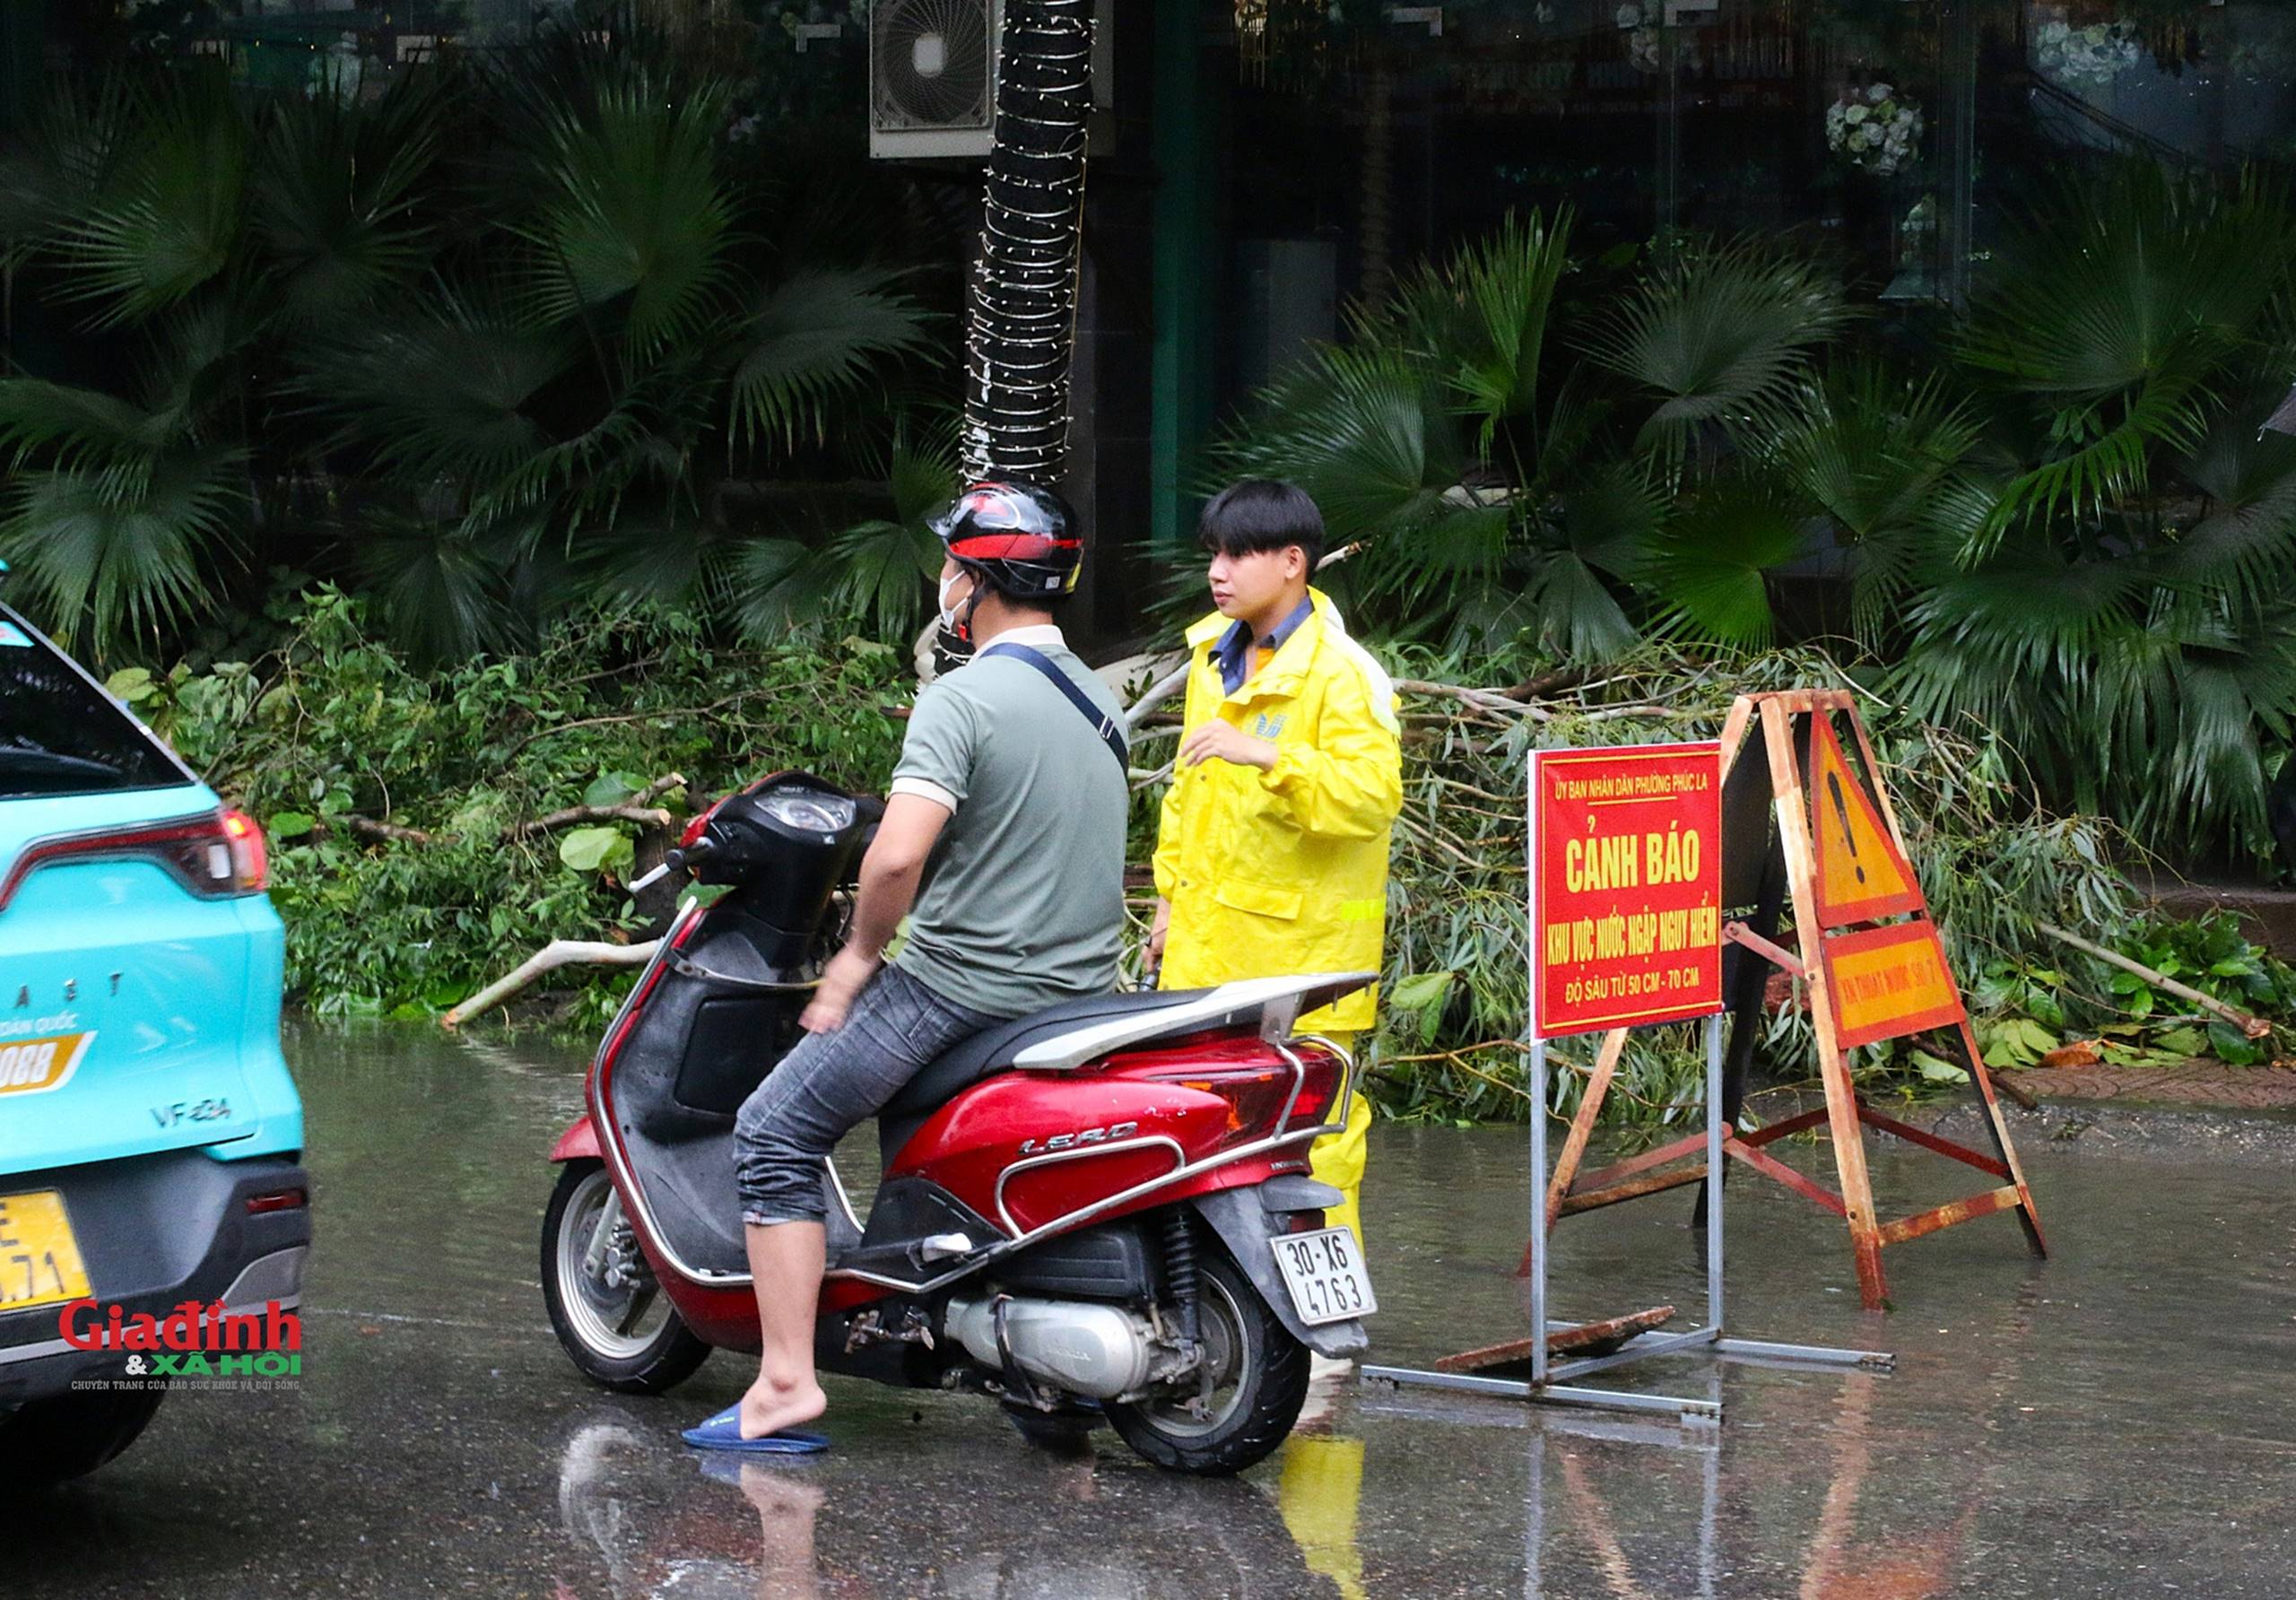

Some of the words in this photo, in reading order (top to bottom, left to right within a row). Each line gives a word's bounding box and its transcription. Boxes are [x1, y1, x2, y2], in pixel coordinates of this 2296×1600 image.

[1570, 780, 1587, 799] BAN
[1589, 774, 1613, 798] NHÂN
[1616, 773, 1634, 796] DÂN
[1635, 770, 1671, 795] PHƯỜNG
[1673, 770, 1695, 792] PHÚC
[1696, 772, 1708, 790] LA
[1566, 814, 1639, 893] CẢNH
[1647, 820, 1700, 884] BÁO
[1547, 922, 1570, 966] KHU
[1572, 916, 1594, 970] VỰC
[1596, 904, 1626, 961] NƯỚC
[1628, 905, 1657, 963] NGẬP
[1659, 909, 1688, 952] NGUY
[1690, 891, 1717, 949] HIỂM
[1565, 977, 1582, 1007] ĐỘ
[1585, 975, 1608, 1001] SÂU
[1611, 970, 1627, 996] TỪ
[1628, 975, 1641, 996] 50
[1643, 971, 1660, 993] CM
[1667, 970, 1681, 989] 70
[1683, 967, 1700, 987] CM
[1018, 1121, 1138, 1155] LEAD
[1305, 1274, 1361, 1316] 4763
